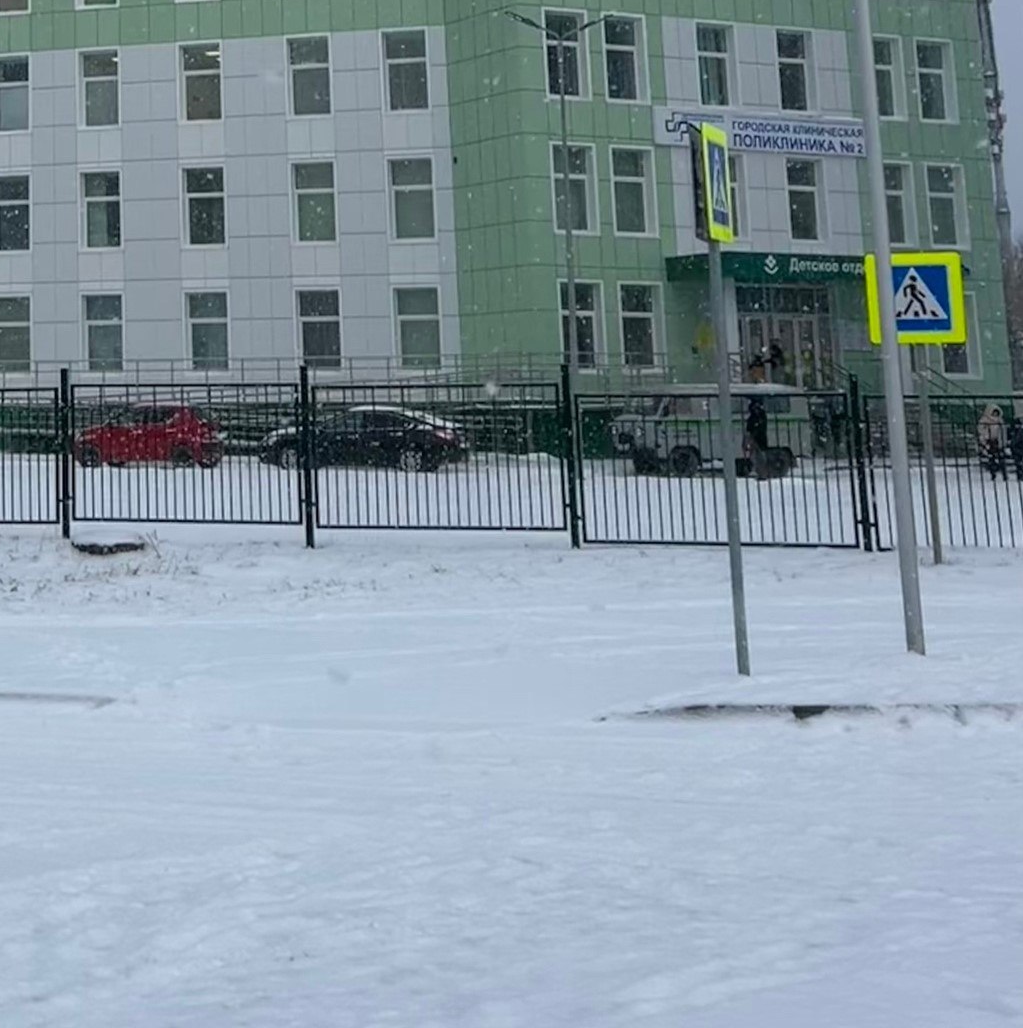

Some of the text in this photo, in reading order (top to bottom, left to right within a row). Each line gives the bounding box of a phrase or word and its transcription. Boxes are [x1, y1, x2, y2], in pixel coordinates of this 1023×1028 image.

[732, 121, 863, 138] ГОРОДСКАЯ КЛИНИЧЕСКАЯ
[733, 134, 864, 153] ПОЛИКЛИНИКА № 2
[789, 257, 865, 275] Детское отд
